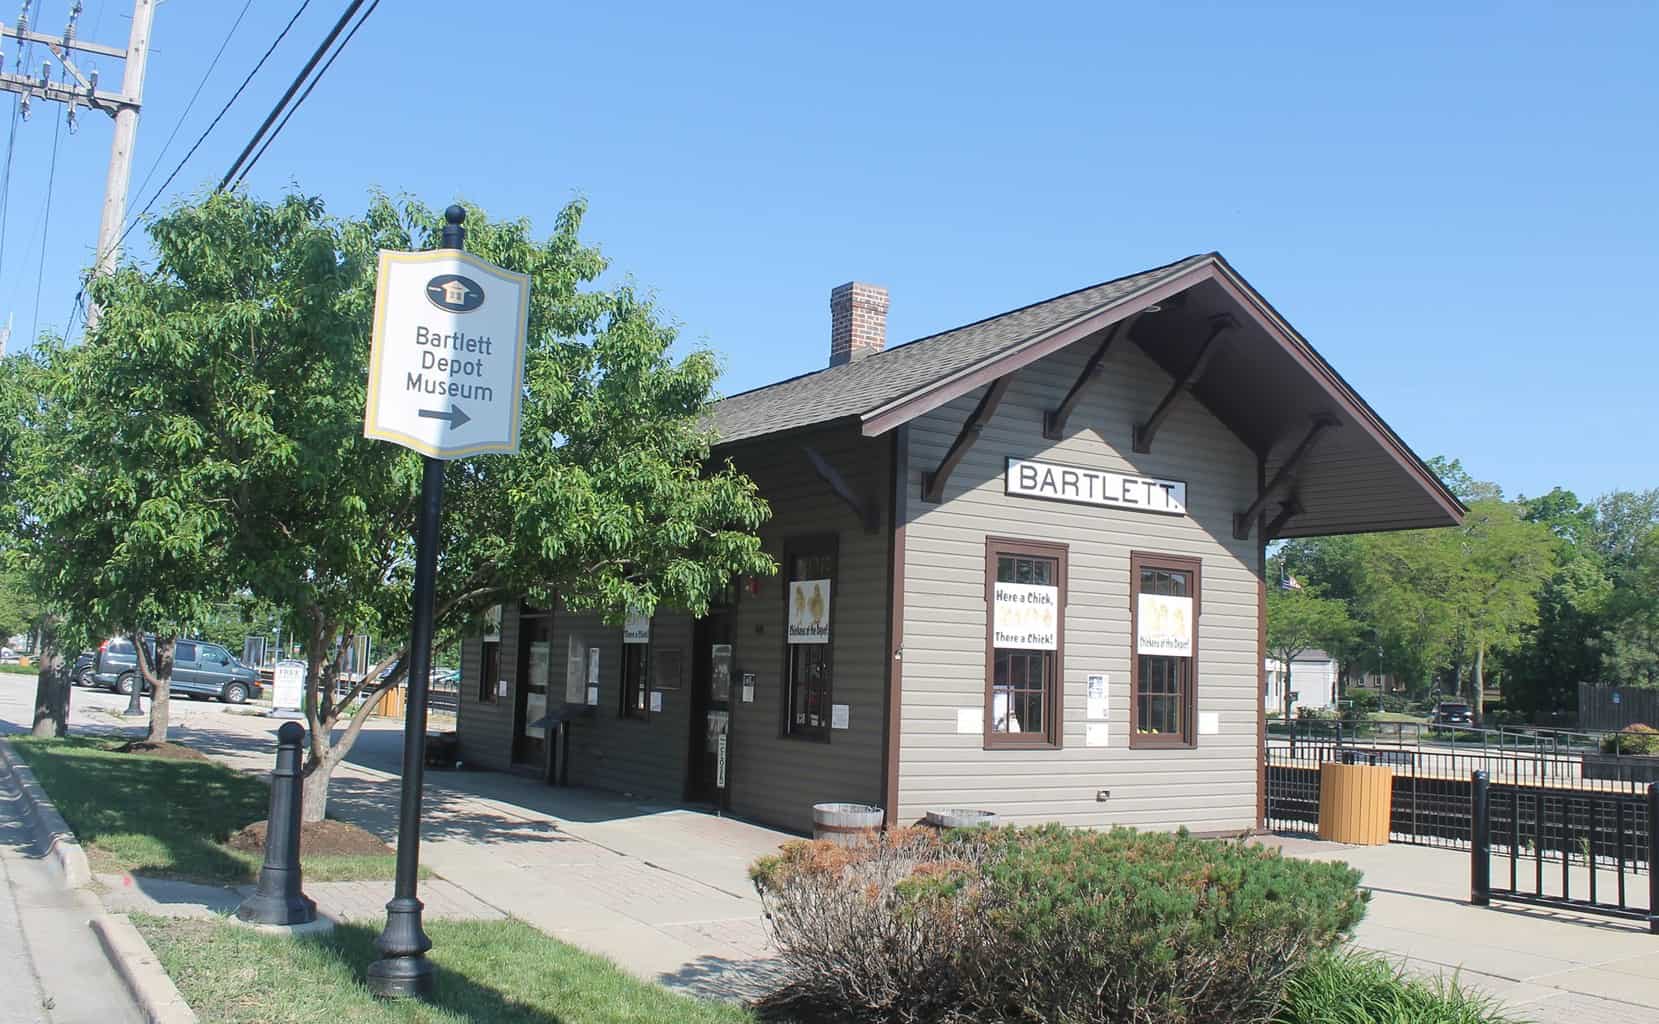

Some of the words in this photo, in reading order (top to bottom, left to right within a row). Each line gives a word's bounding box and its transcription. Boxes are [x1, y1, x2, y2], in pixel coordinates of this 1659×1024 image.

[416, 326, 492, 355] Bartlett
[422, 350, 483, 377] Depot
[406, 372, 493, 402] Museum
[996, 589, 1018, 602] Here
[995, 632, 1018, 643] There
[1027, 633, 1054, 645] Chick!
